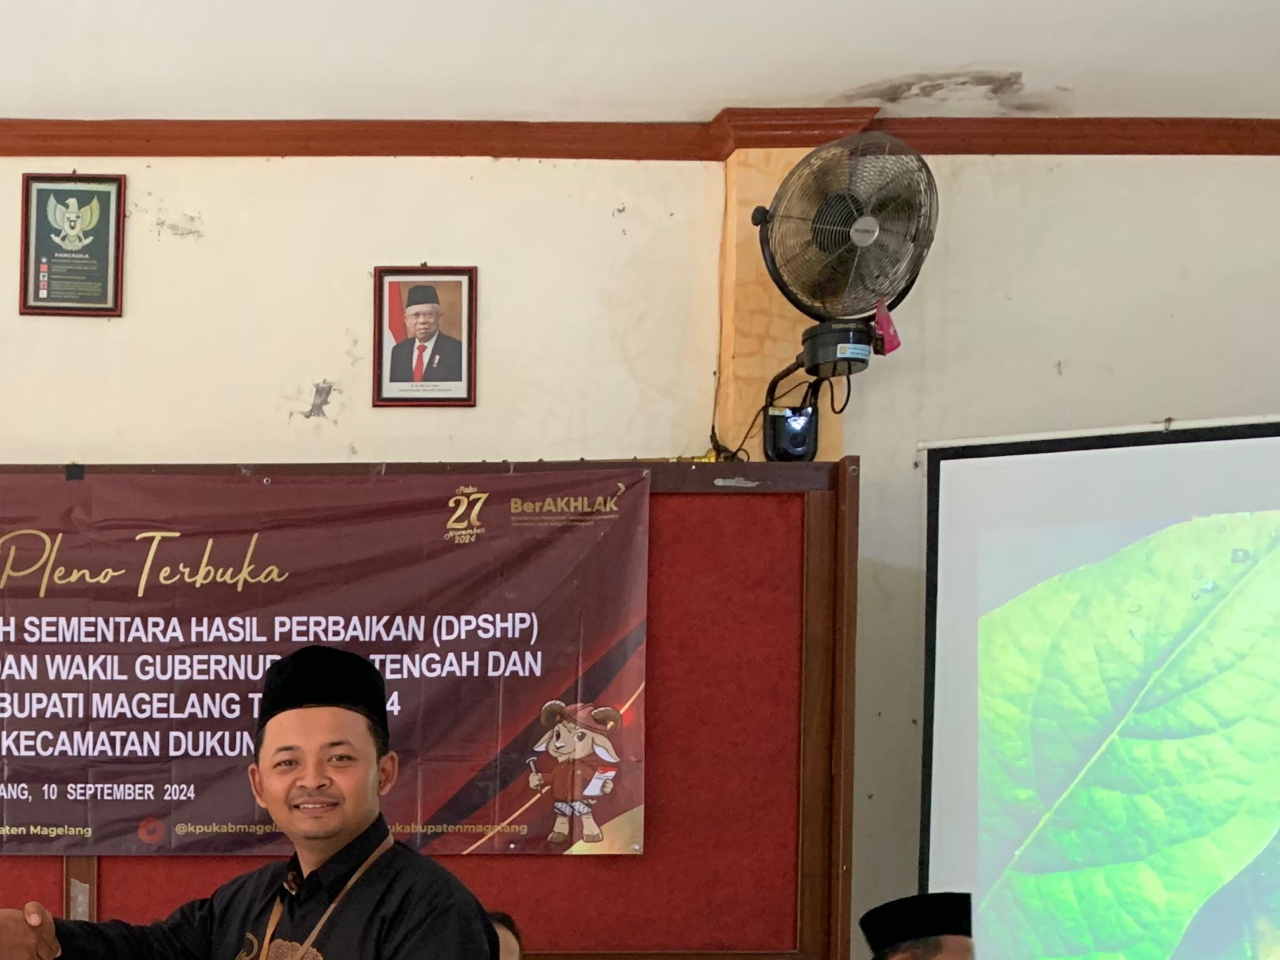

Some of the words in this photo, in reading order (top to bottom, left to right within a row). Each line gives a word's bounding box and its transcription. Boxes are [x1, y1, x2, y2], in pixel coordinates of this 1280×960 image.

[446, 492, 489, 529] 27
[510, 496, 619, 513] BerAKHLAK
[444, 527, 486, 541] November
[454, 534, 476, 544] 2024
[135, 531, 289, 598] Terbuka
[23, 616, 185, 643] SEMENTARA
[190, 616, 267, 643] HASIL
[274, 615, 426, 642] PERBAIKAN
[433, 612, 539, 647] (DPSHP)
[45, 654, 128, 680] WAKIL
[369, 651, 479, 679] TENGAH
[487, 651, 542, 677] DAN
[92, 692, 241, 719] MAGELANG
[1, 730, 160, 757] KECAMATAN
[169, 731, 255, 757] DUKUN
[42, 784, 58, 800] 10
[67, 784, 155, 800] SEPTEMBER
[164, 784, 195, 800] 2024
[30, 824, 92, 837] Magelang
[388, 822, 528, 835] ukabupatenmagelang
